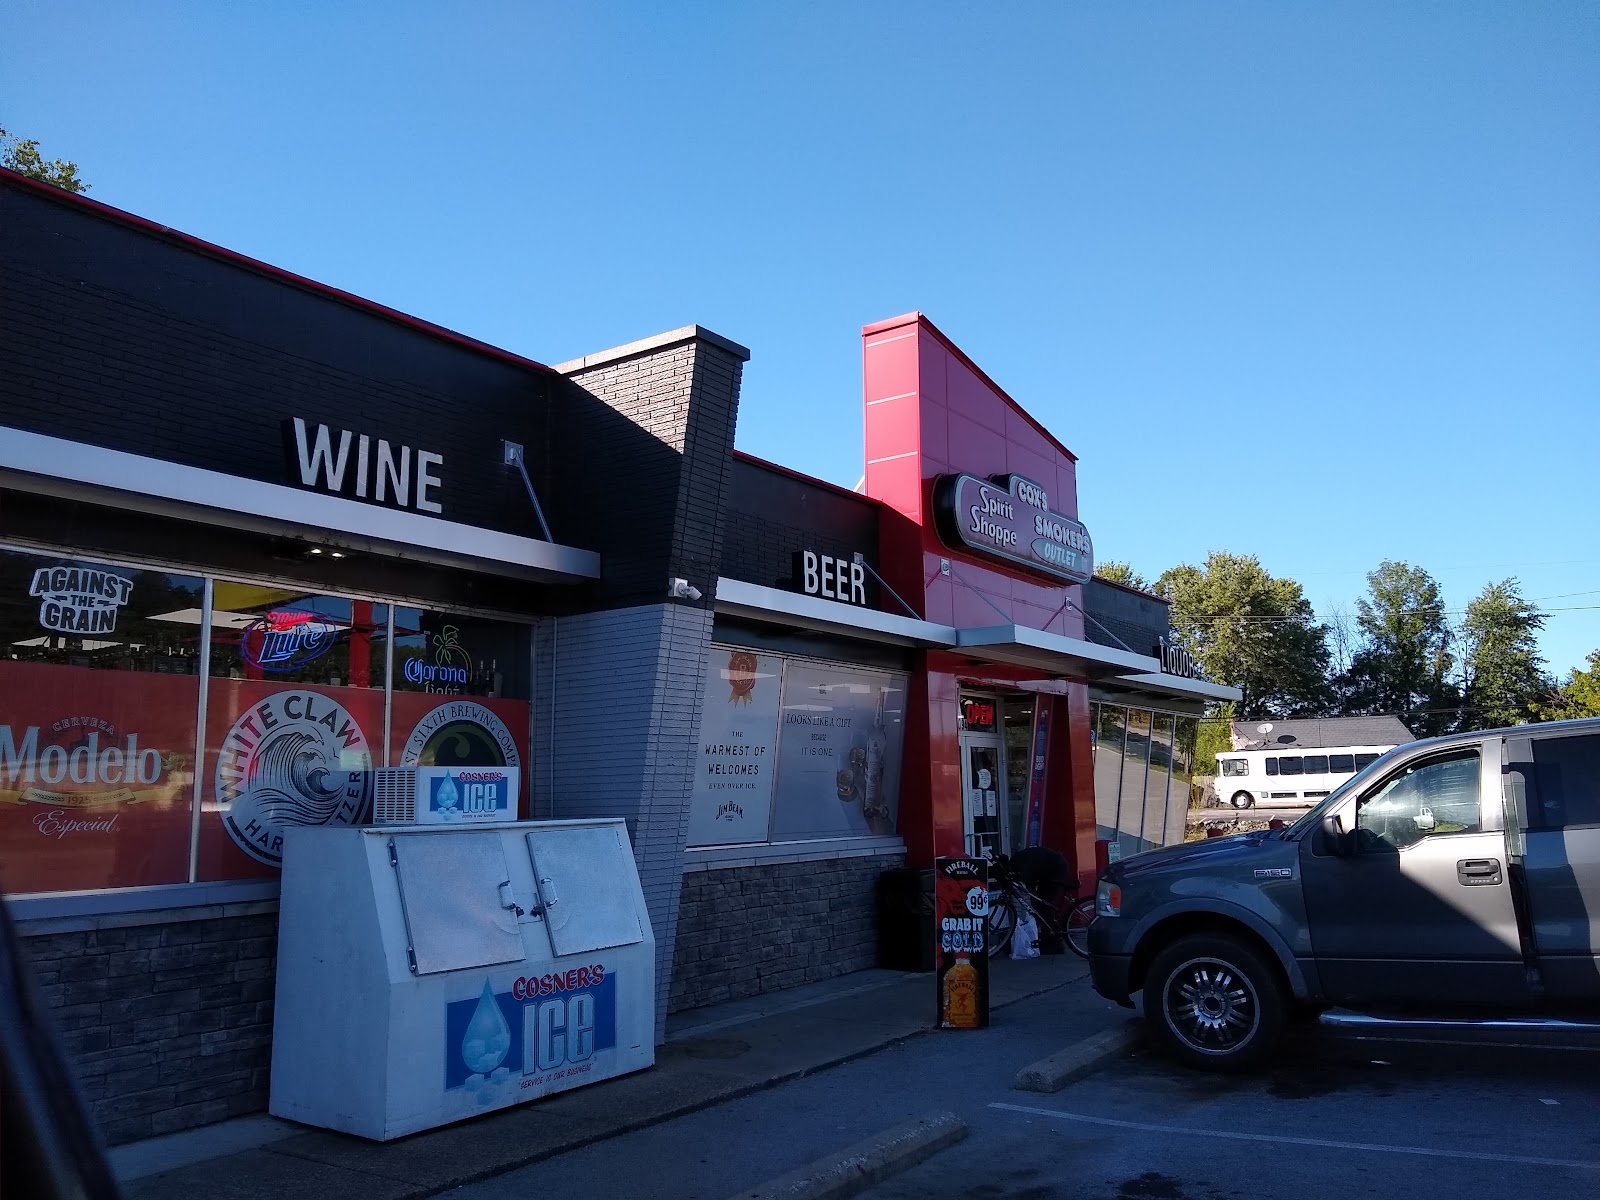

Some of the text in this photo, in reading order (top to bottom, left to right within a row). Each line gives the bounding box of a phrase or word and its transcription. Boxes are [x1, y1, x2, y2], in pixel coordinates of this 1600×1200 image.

[293, 416, 443, 514] WINE
[979, 485, 1014, 520] Spirit
[970, 505, 1017, 547] Shoppe
[1044, 542, 1077, 567] OUTLET
[34, 569, 132, 602] AGAINST
[803, 550, 866, 605] BEER
[70, 594, 96, 608] THE
[44, 602, 116, 632] GRAIN
[257, 624, 325, 663] Lite
[404, 657, 467, 684] Corona
[1161, 645, 1195, 677] LIQUOR
[52, 716, 115, 735] CERVEZA
[450, 704, 497, 732] BREWING
[786, 713, 812, 726] LOOKS
[812, 717, 829, 727] LIKE
[836, 718, 852, 728] GIFT
[0, 725, 162, 785] Modelo
[219, 695, 361, 804] WHITE CLAW
[705, 744, 766, 757] WARMEST OF
[801, 747, 833, 757] IT IS ONE
[708, 763, 759, 775] WELCOMES
[708, 782, 726, 790] EVEN
[727, 782, 744, 790] OVER
[244, 818, 284, 852] HAR
[945, 861, 979, 875] FIREBALL
[942, 917, 984, 931] GRAB IT
[941, 932, 985, 953] COLD
